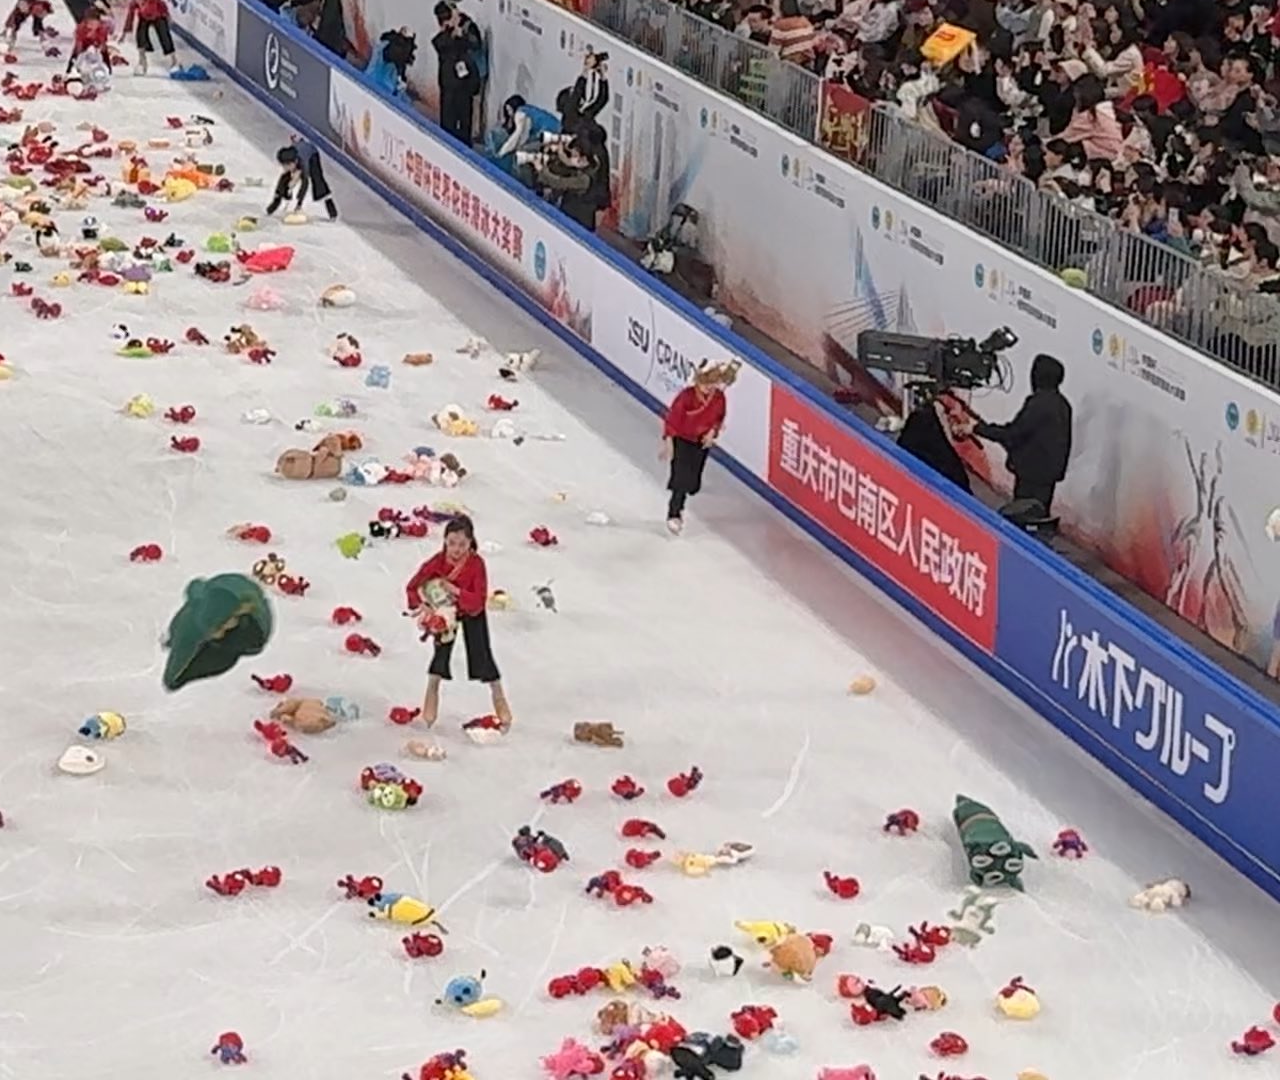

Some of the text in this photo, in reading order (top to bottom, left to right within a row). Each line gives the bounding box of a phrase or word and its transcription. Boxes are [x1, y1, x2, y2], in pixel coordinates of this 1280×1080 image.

[628, 316, 650, 354] ISU
[780, 418, 988, 618] 重庆市巴南区人民政府
[1079, 629, 1237, 805] 木下グループ
